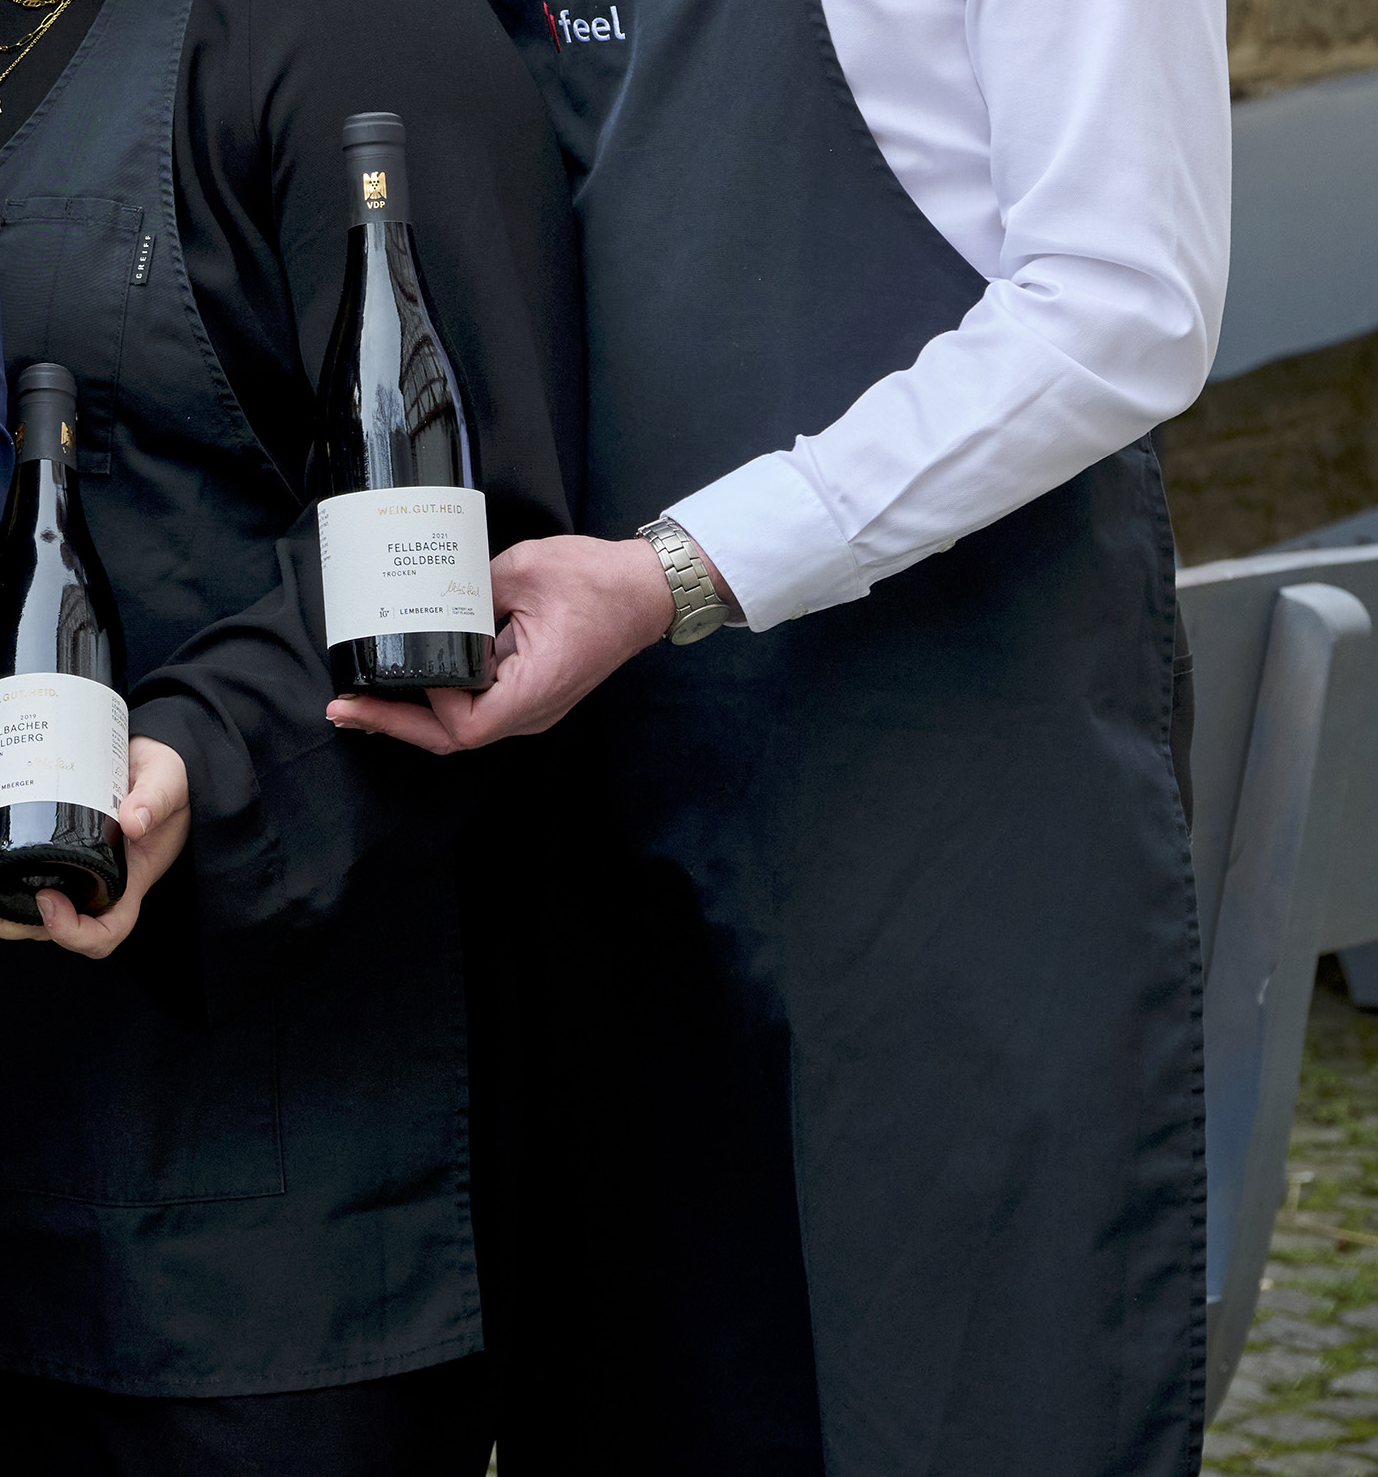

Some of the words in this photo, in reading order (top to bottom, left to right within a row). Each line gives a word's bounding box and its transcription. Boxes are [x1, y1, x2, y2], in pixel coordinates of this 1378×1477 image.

[558, 5, 626, 44] feel
[366, 200, 386, 210] VDP
[135, 235, 151, 279] GREIFF
[387, 541, 459, 554] FELLBACHER
[393, 555, 456, 567] GOLDBERG
[382, 569, 417, 578] TROCKEN
[399, 606, 444, 615] LEMBERGER
[20, 713, 37, 721] 2019
